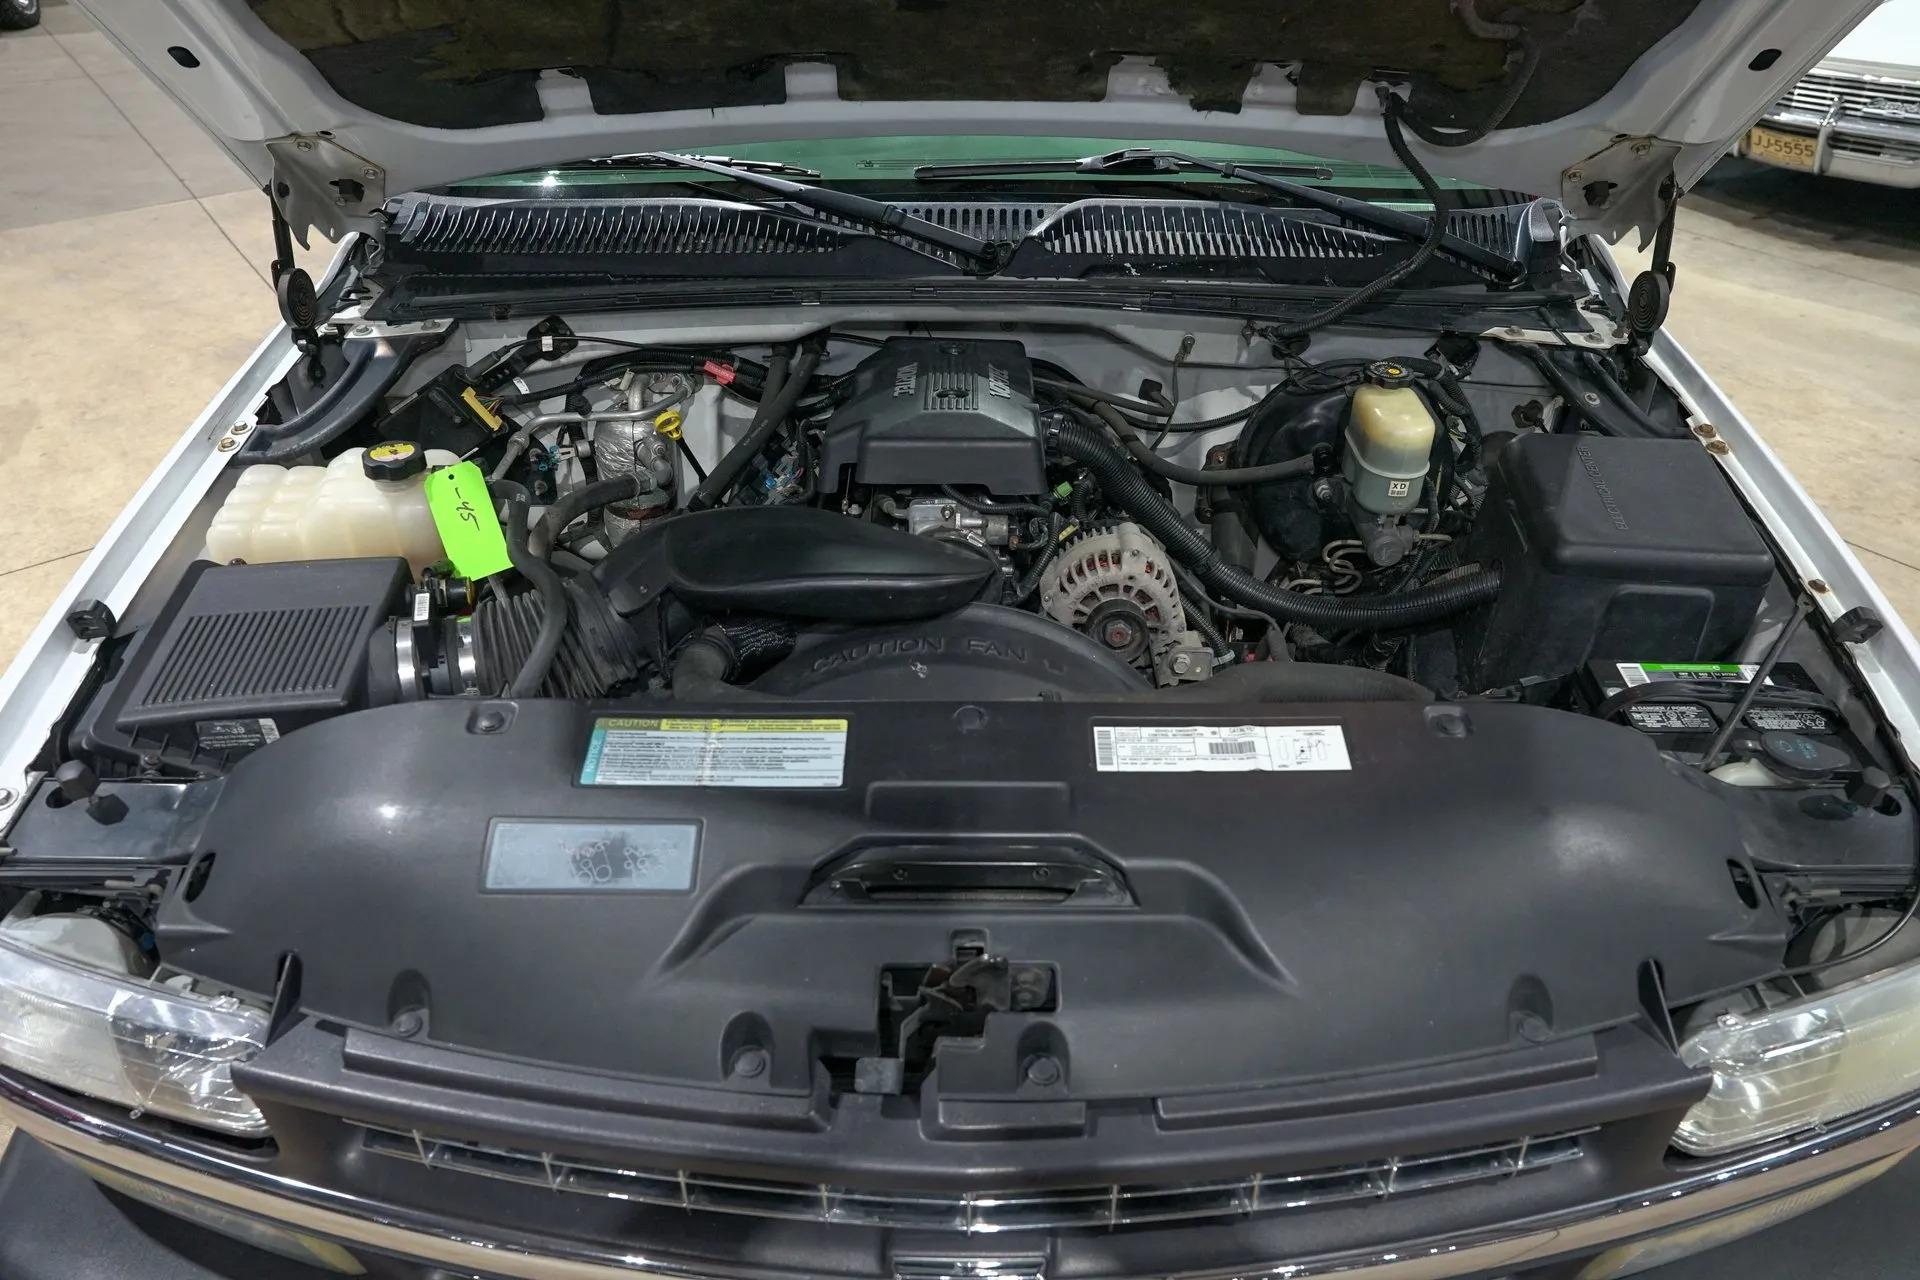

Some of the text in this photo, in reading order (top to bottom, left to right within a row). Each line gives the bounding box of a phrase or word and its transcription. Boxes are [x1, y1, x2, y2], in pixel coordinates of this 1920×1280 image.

[811, 637, 945, 673] CAUTION
[967, 639, 1028, 663] FAN
[608, 719, 659, 728] CAUTION
